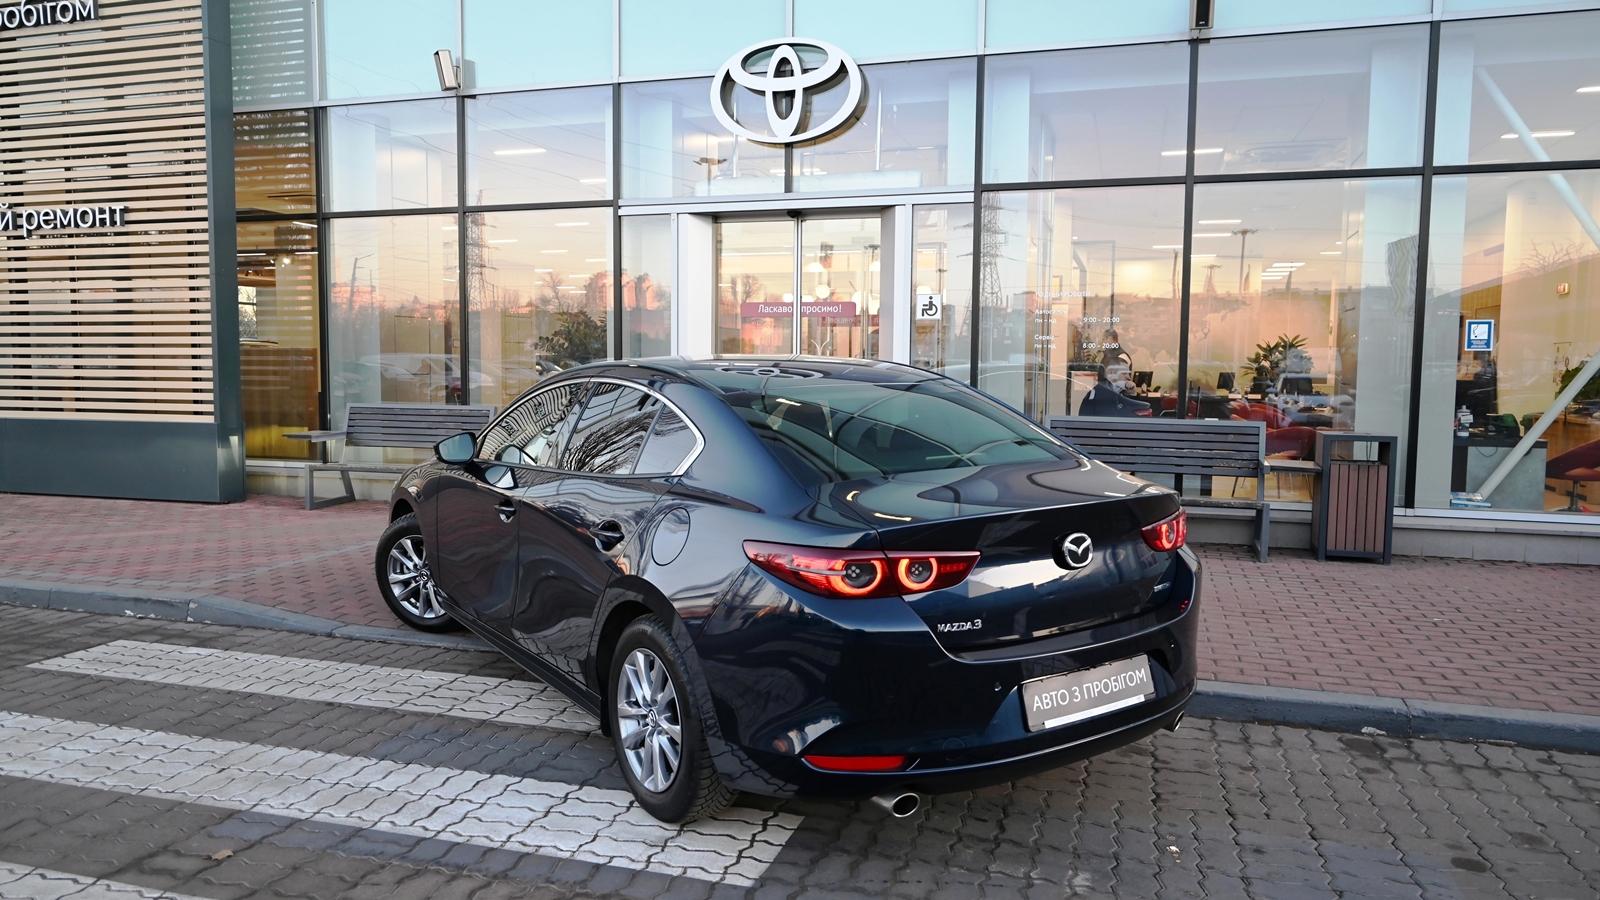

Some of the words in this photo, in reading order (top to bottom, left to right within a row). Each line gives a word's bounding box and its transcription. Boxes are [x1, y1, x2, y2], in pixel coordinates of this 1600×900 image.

[0, 0, 95, 28] обігом
[23, 205, 125, 237] ремонт
[757, 304, 792, 313] Ласкаво
[801, 304, 842, 314] просимо!
[1033, 688, 1070, 712] АВТО
[1082, 667, 1147, 700] ПРОБІГОМ
